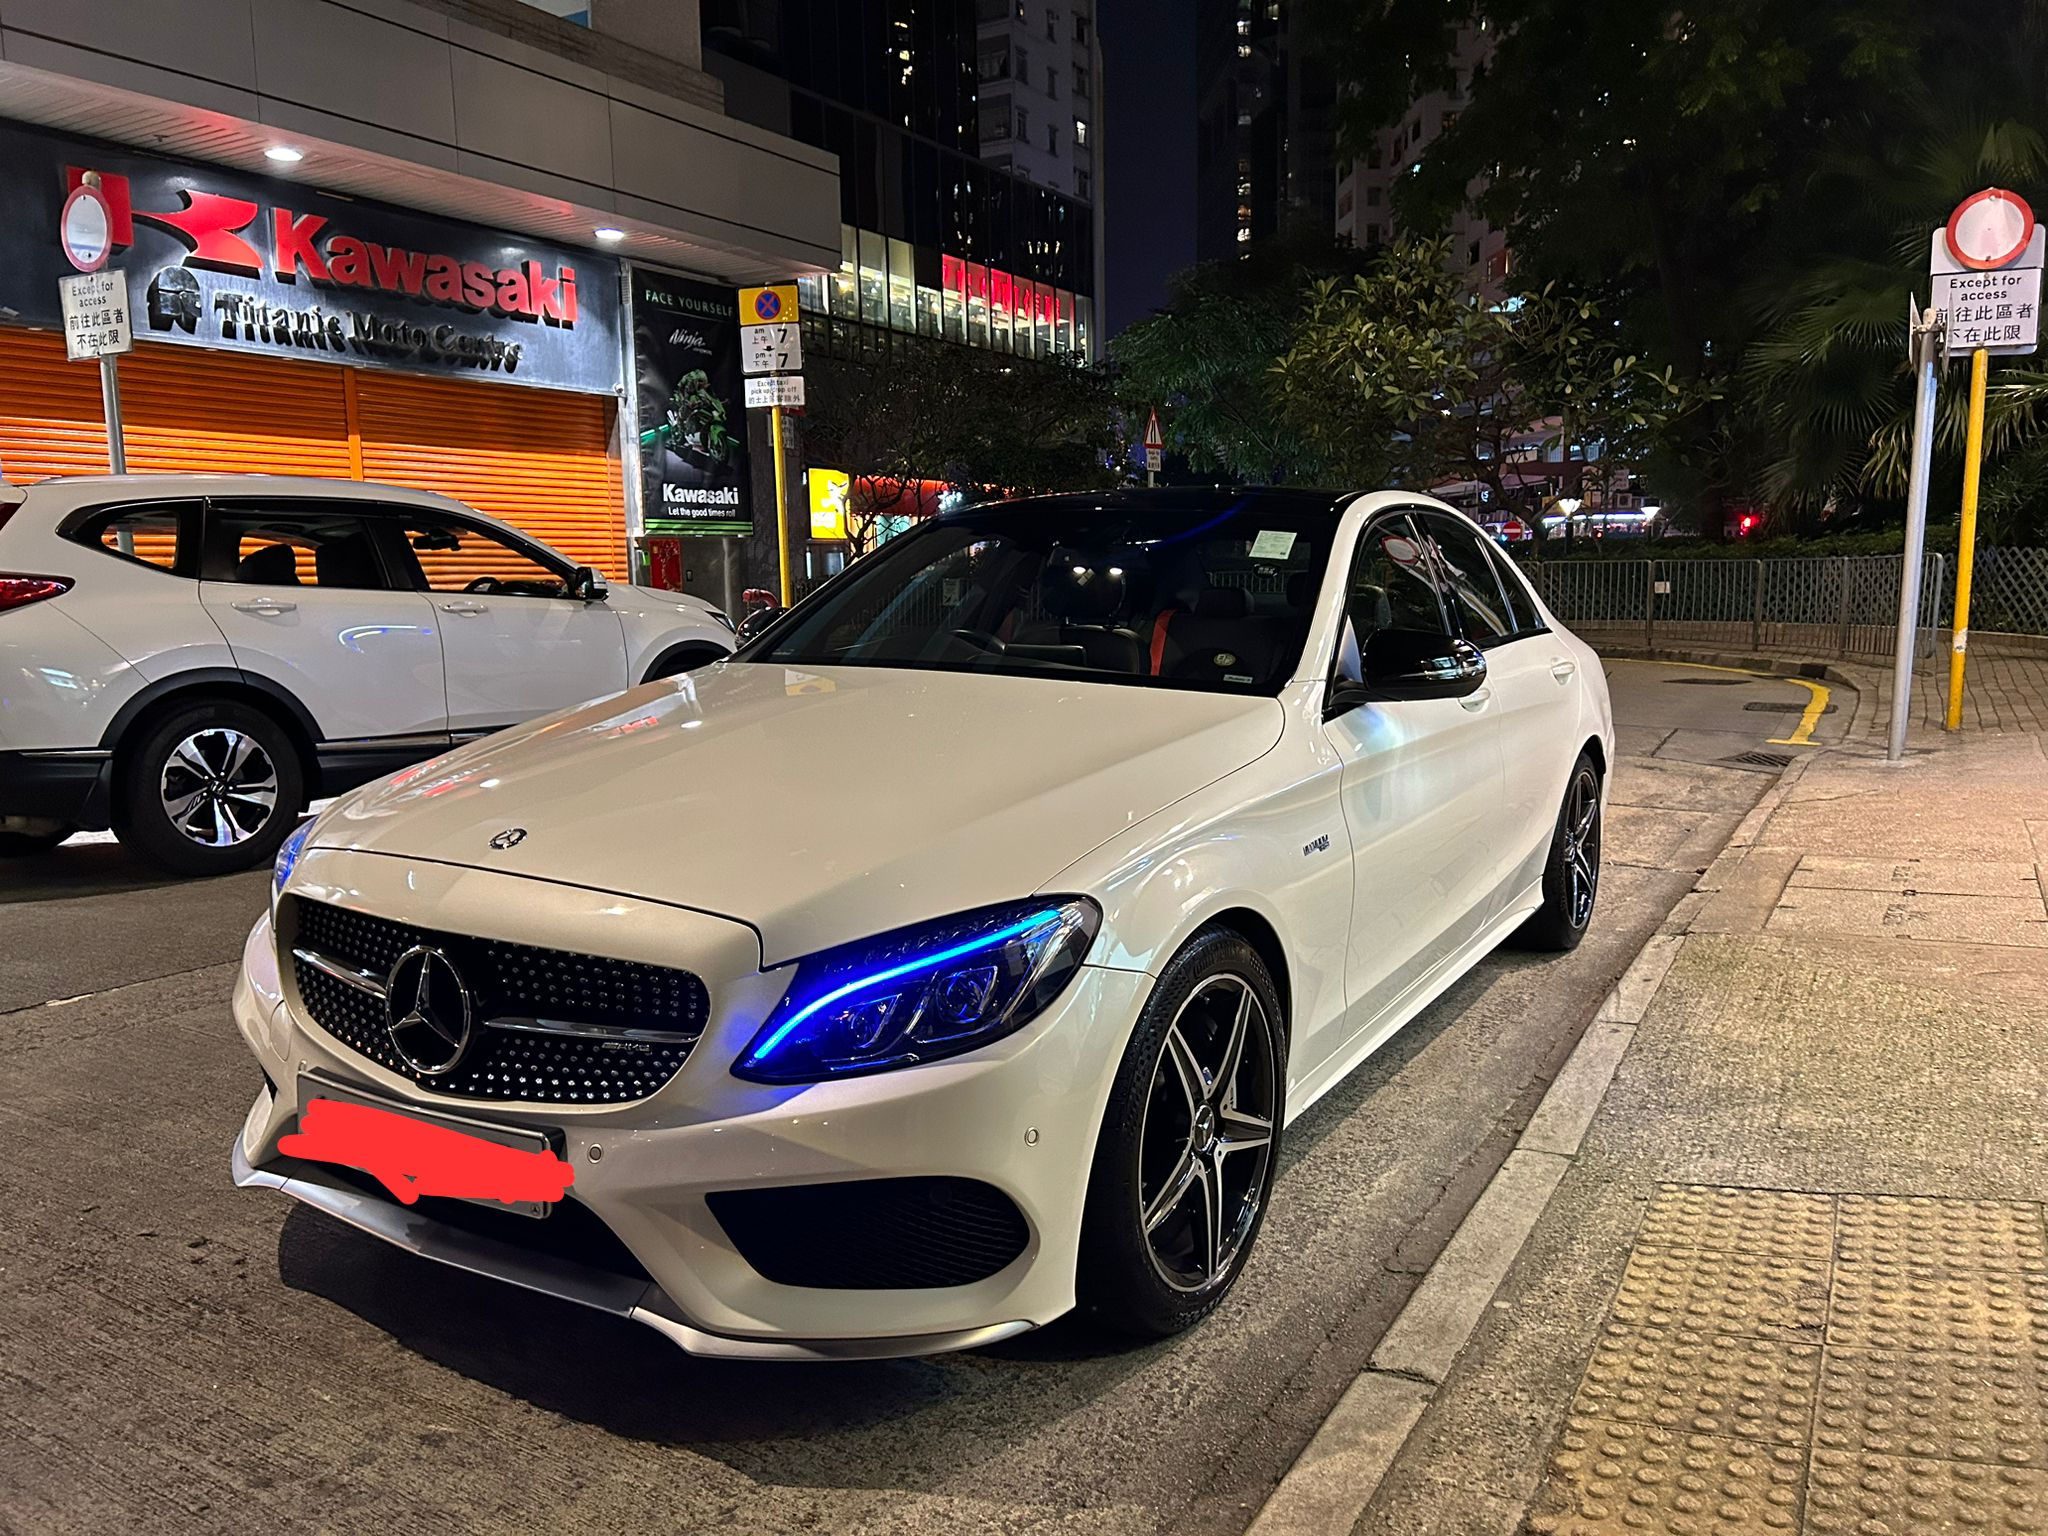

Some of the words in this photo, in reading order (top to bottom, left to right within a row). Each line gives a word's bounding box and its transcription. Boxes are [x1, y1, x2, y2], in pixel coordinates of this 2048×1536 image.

[271, 207, 578, 325] Kawasaki
[72, 284, 100, 297] Except
[101, 281, 114, 292] for
[1950, 277, 1998, 288] Except
[2002, 275, 2022, 285] for
[79, 295, 107, 307] access
[645, 289, 673, 306] FACE
[678, 297, 733, 317] YOURSELF
[1961, 290, 2007, 301] access
[69, 308, 123, 330] 前往此區者
[215, 292, 341, 339] Titanic
[348, 311, 428, 349] Moto
[433, 324, 524, 364] Centre
[777, 328, 788, 344] 7
[76, 329, 119, 349] 不在此限
[668, 328, 706, 350] Ninja
[752, 336, 768, 344] 上午
[753, 360, 769, 368] 下午
[778, 353, 788, 367] 7
[662, 483, 739, 505] Kawasaki
[668, 506, 680, 516] Let
[680, 507, 691, 516] the
[691, 508, 707, 518] good
[708, 508, 725, 517] times
[726, 509, 736, 517] roll
